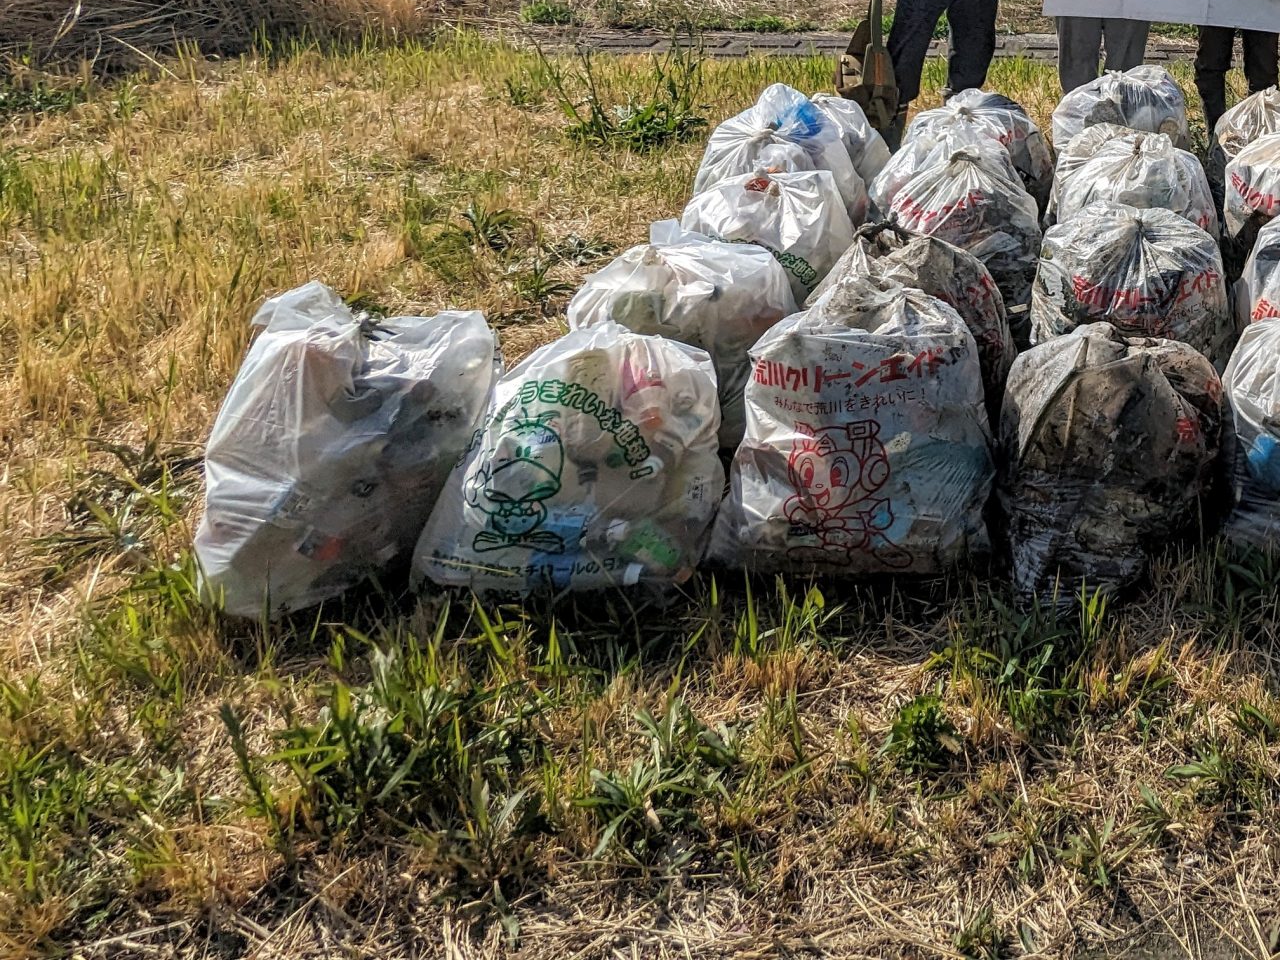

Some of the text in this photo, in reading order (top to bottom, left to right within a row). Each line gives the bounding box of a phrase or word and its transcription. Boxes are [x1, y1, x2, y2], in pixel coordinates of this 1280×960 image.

[754, 346, 948, 393] 荒川クリーンエイド
